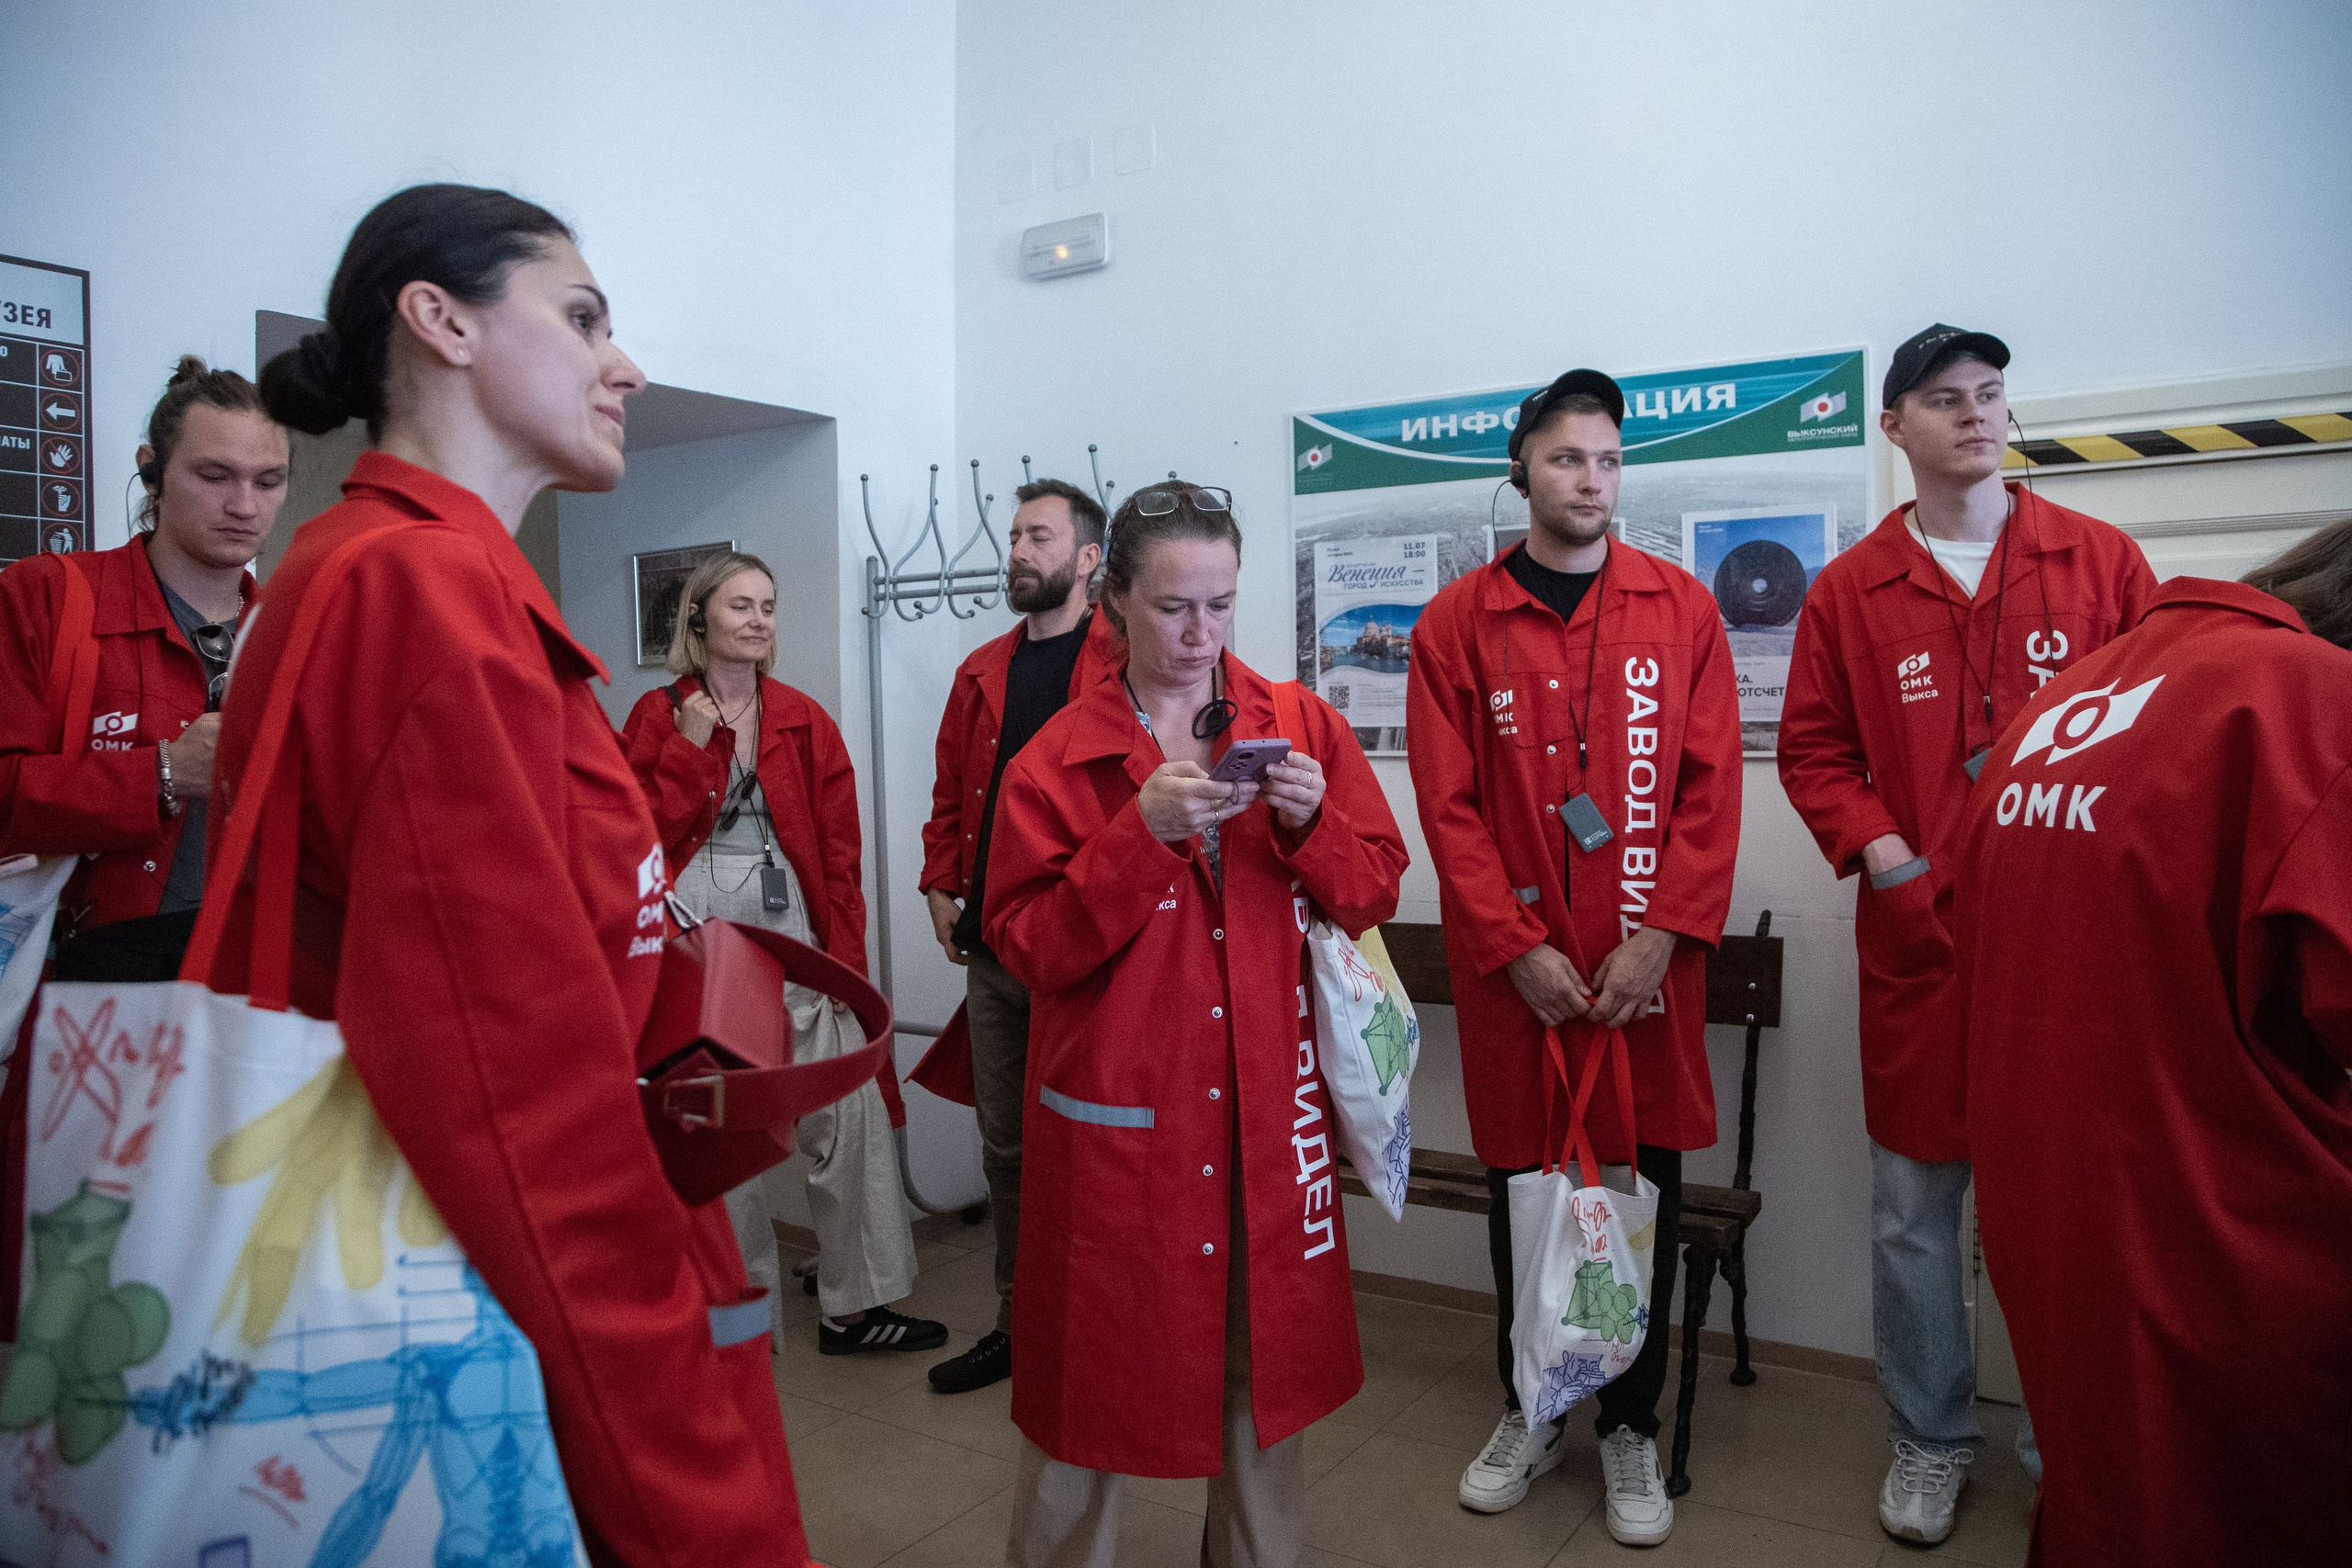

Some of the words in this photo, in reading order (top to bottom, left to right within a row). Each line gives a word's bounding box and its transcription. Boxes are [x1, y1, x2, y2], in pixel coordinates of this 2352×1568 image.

[0, 299, 51, 329] ЗЕЯ
[1787, 423, 1859, 438] ВЫКСУНСКИЙ
[0, 434, 30, 450] АТЫ
[1404, 542, 1426, 550] 11.07
[1404, 550, 1426, 558] 18:00
[1328, 564, 1407, 588] Венеция
[1380, 579, 1424, 588] ИСКУССТВА
[1901, 675, 1933, 691] ОМК
[1737, 686, 1785, 697] ОТСЧЕТ
[1902, 689, 1939, 704] Выкса
[91, 739, 134, 751] ОМК
[1624, 656, 1659, 833] ЗАВОД
[1996, 782, 2108, 832] ОМК
[1156, 899, 1177, 911] кса
